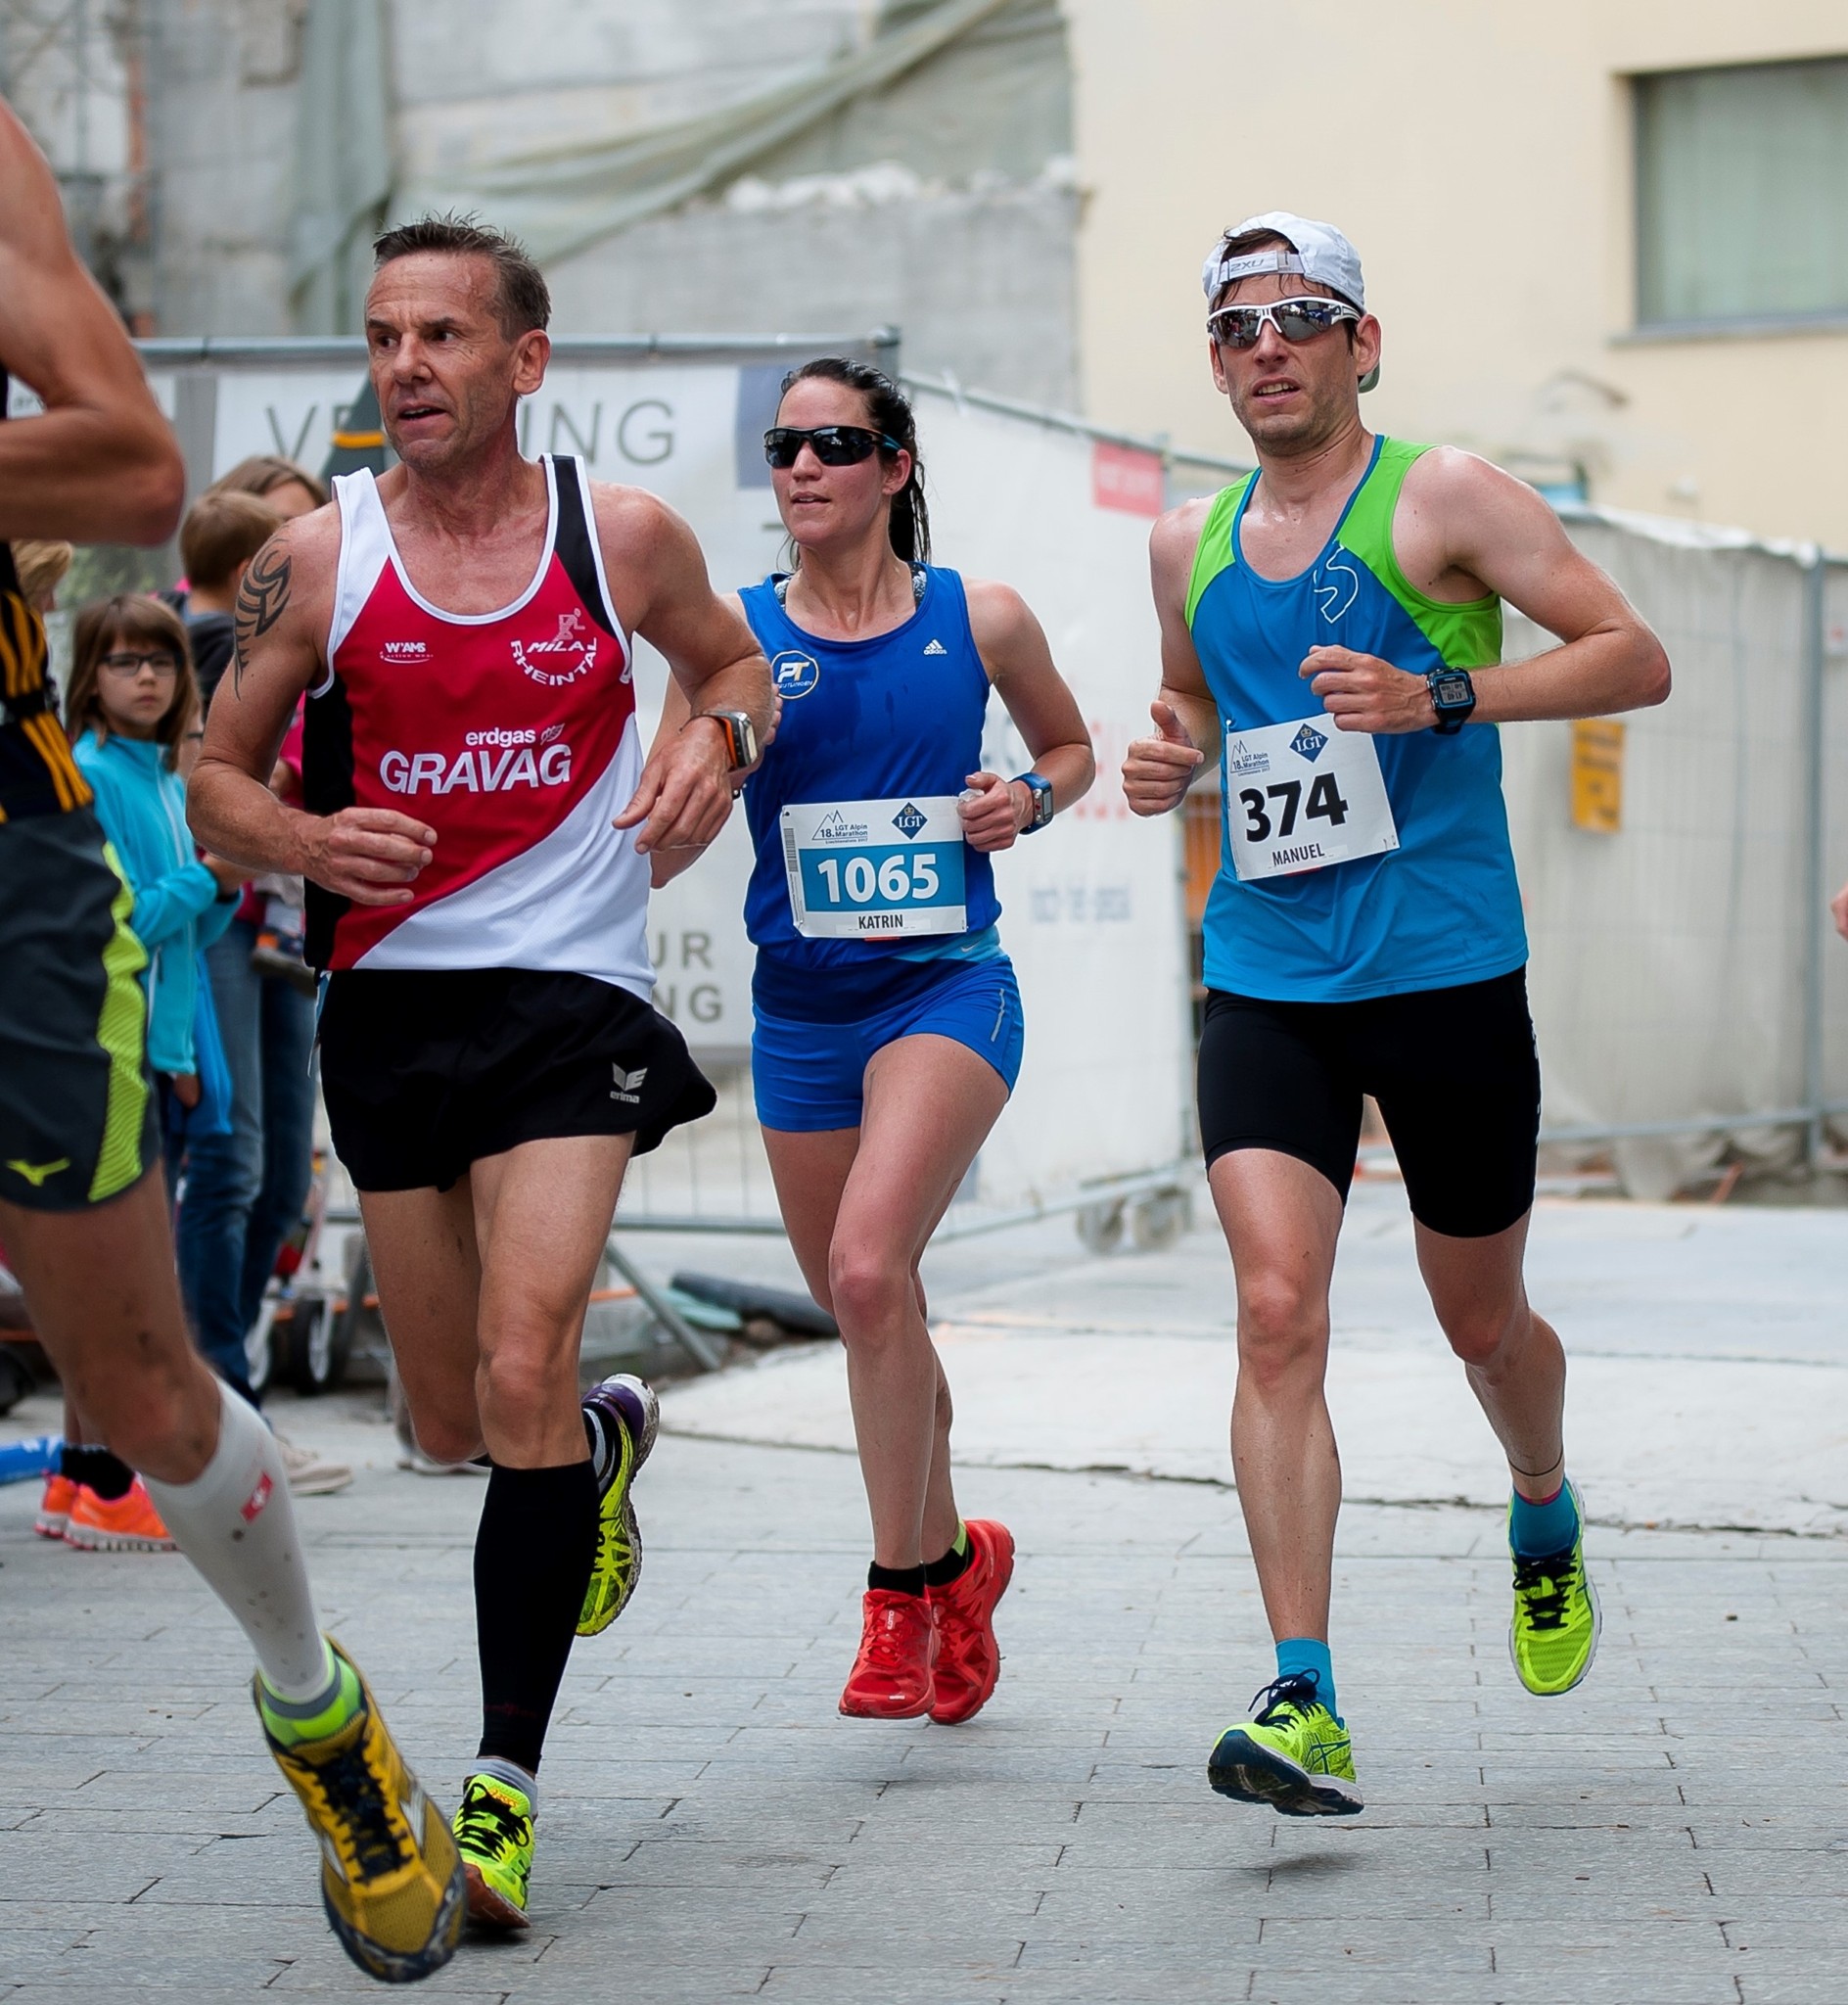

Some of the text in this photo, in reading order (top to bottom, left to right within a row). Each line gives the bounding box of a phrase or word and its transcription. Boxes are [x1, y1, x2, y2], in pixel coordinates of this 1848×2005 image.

[1230, 258, 1265, 272] 2XU
[510, 636, 598, 686] RHEINTAL
[465, 726, 536, 748] erdgas
[1295, 734, 1323, 753] LGT
[379, 743, 573, 795] GRAVAG
[1238, 771, 1349, 843] 374
[898, 815, 923, 828] LGT
[1272, 842, 1325, 866] MANUEL
[817, 853, 940, 904] 1065
[858, 913, 903, 930] KATRIN
[609, 1091, 640, 1104] erima
